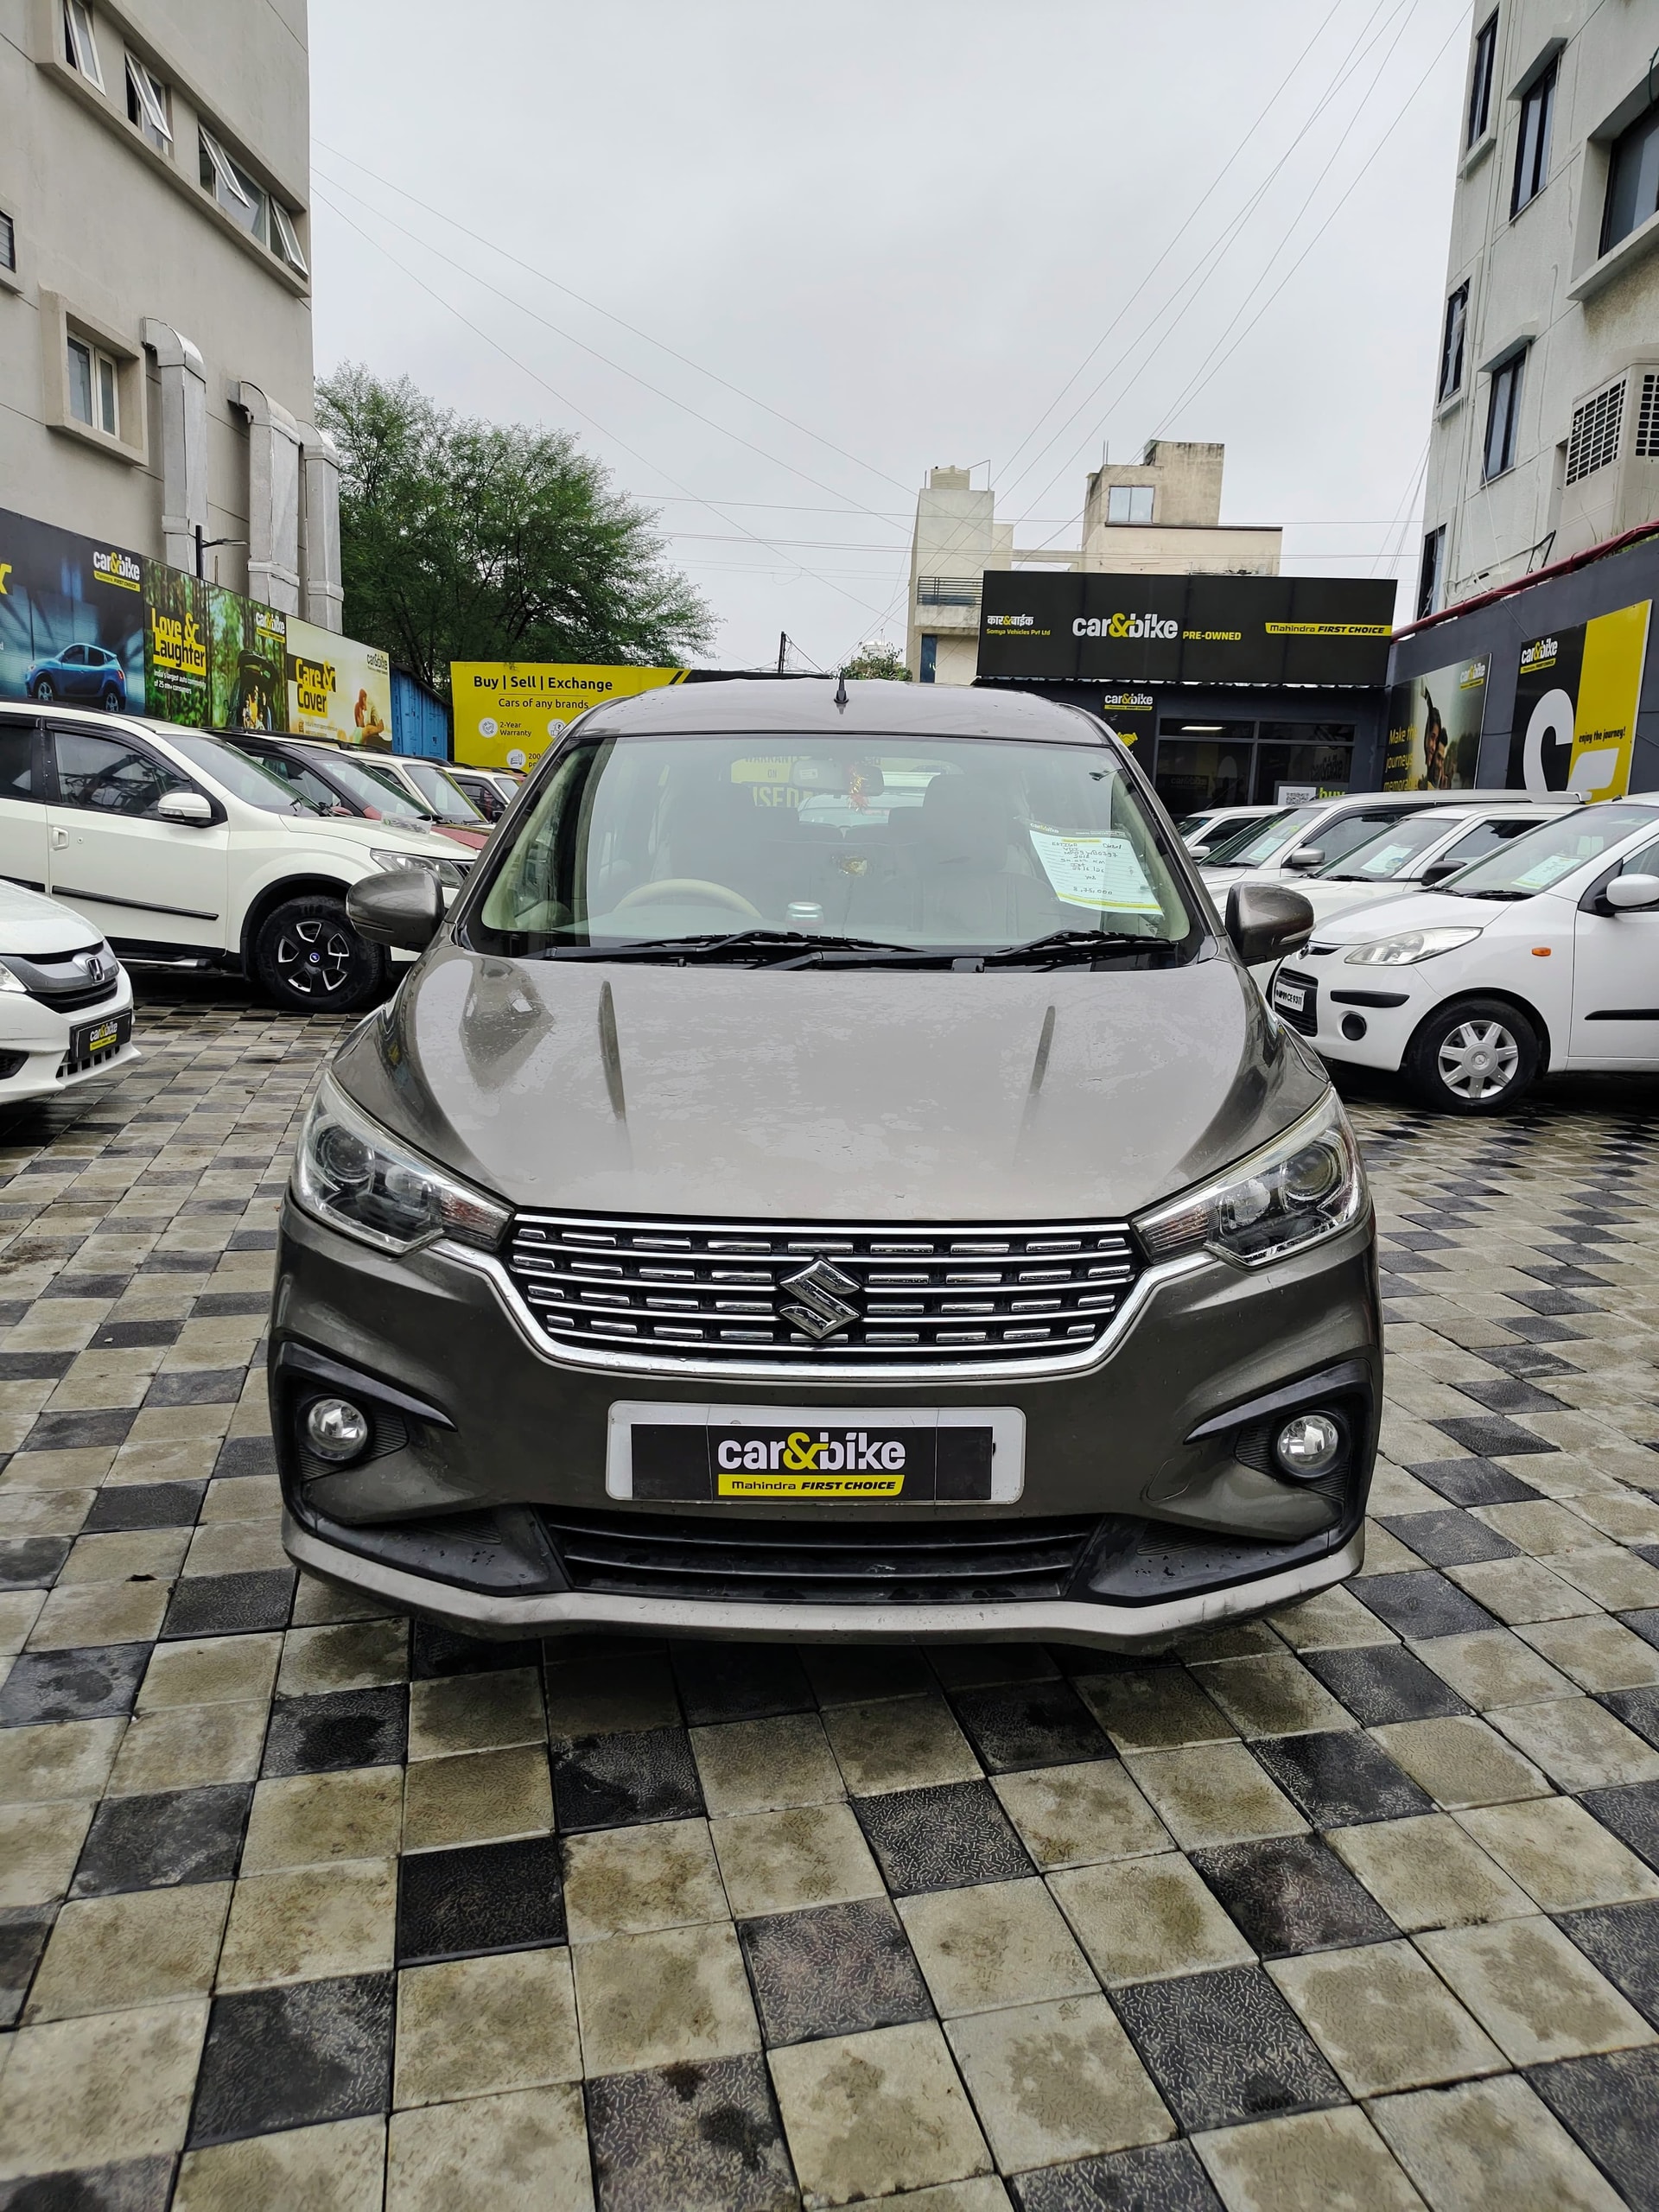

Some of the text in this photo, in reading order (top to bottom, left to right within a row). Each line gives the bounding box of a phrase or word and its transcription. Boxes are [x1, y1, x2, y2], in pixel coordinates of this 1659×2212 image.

[93, 551, 140, 581] car&bike
[151, 607, 200, 644] Love &
[256, 612, 285, 635] car&bike
[1072, 613, 1242, 641] car&bike PRE-OWNED
[1269, 624, 1385, 634] Mahindra FIRST CHOICE
[154, 632, 205, 668] Laughter
[1522, 638, 1558, 664] car&bike
[366, 653, 389, 671] car&bike
[296, 658, 321, 690] Care
[1460, 663, 1486, 683] car&bike
[474, 676, 499, 690] Buy
[511, 676, 537, 688] Sell
[548, 677, 613, 692] Exchange
[297, 683, 327, 713] Cover
[499, 698, 588, 709] Cars of any brands
[1104, 693, 1154, 705] car&bike
[1389, 727, 1406, 745] Make
[1579, 726, 1626, 745] enjoy the journey!
[1384, 753, 1413, 773] journeys
[90, 1021, 118, 1042] car&bike
[716, 1431, 906, 1471] car&bike
[731, 1480, 896, 1490] Mahindra FIRST CHOICE
